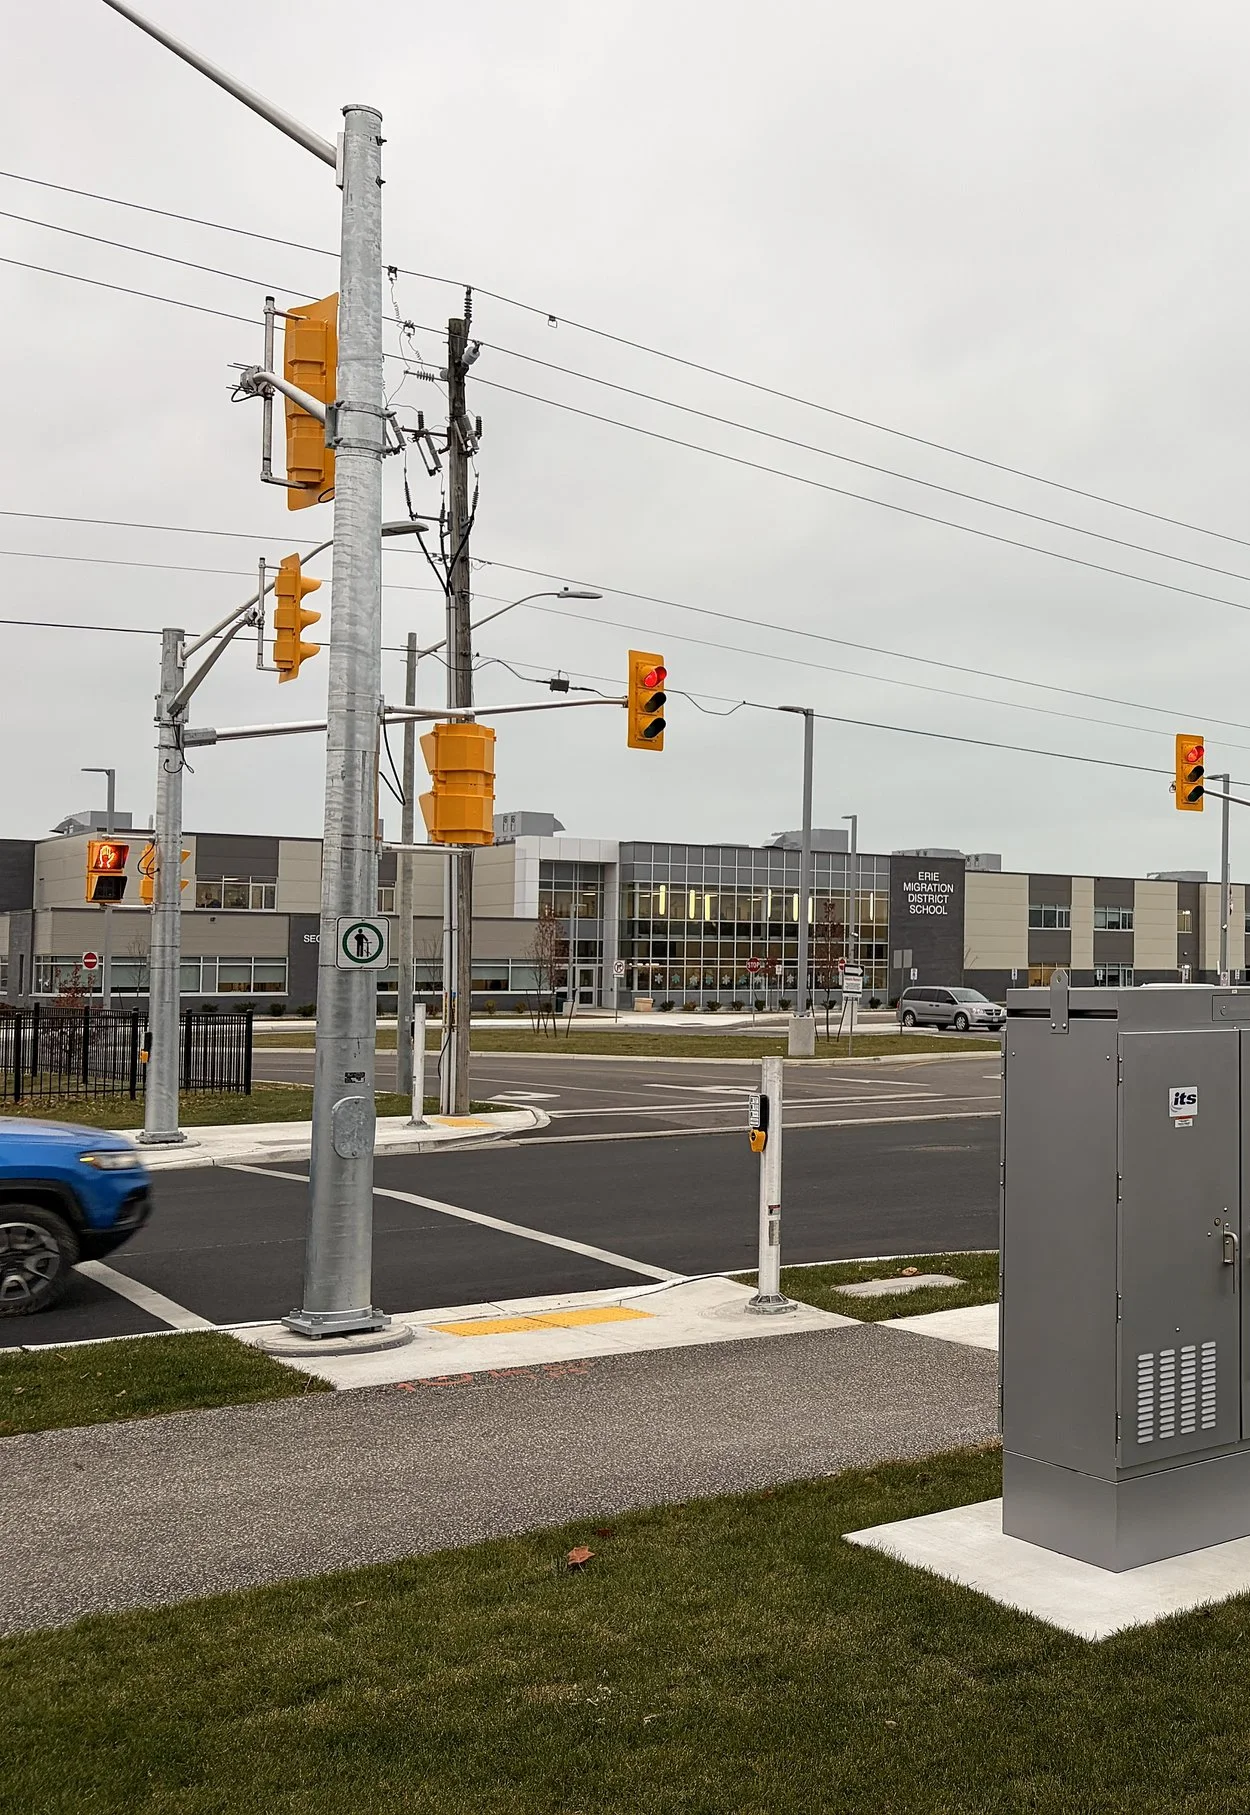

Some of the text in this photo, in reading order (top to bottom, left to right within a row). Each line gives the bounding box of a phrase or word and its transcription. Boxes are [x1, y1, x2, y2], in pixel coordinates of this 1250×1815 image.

[918, 871, 940, 881] ERIE
[903, 882, 954, 893] MIGRATION
[908, 893, 949, 904] DISTRICT
[909, 904, 948, 915] SCHOOL
[747, 961, 760, 969] STOP
[1174, 1092, 1197, 1106] its
